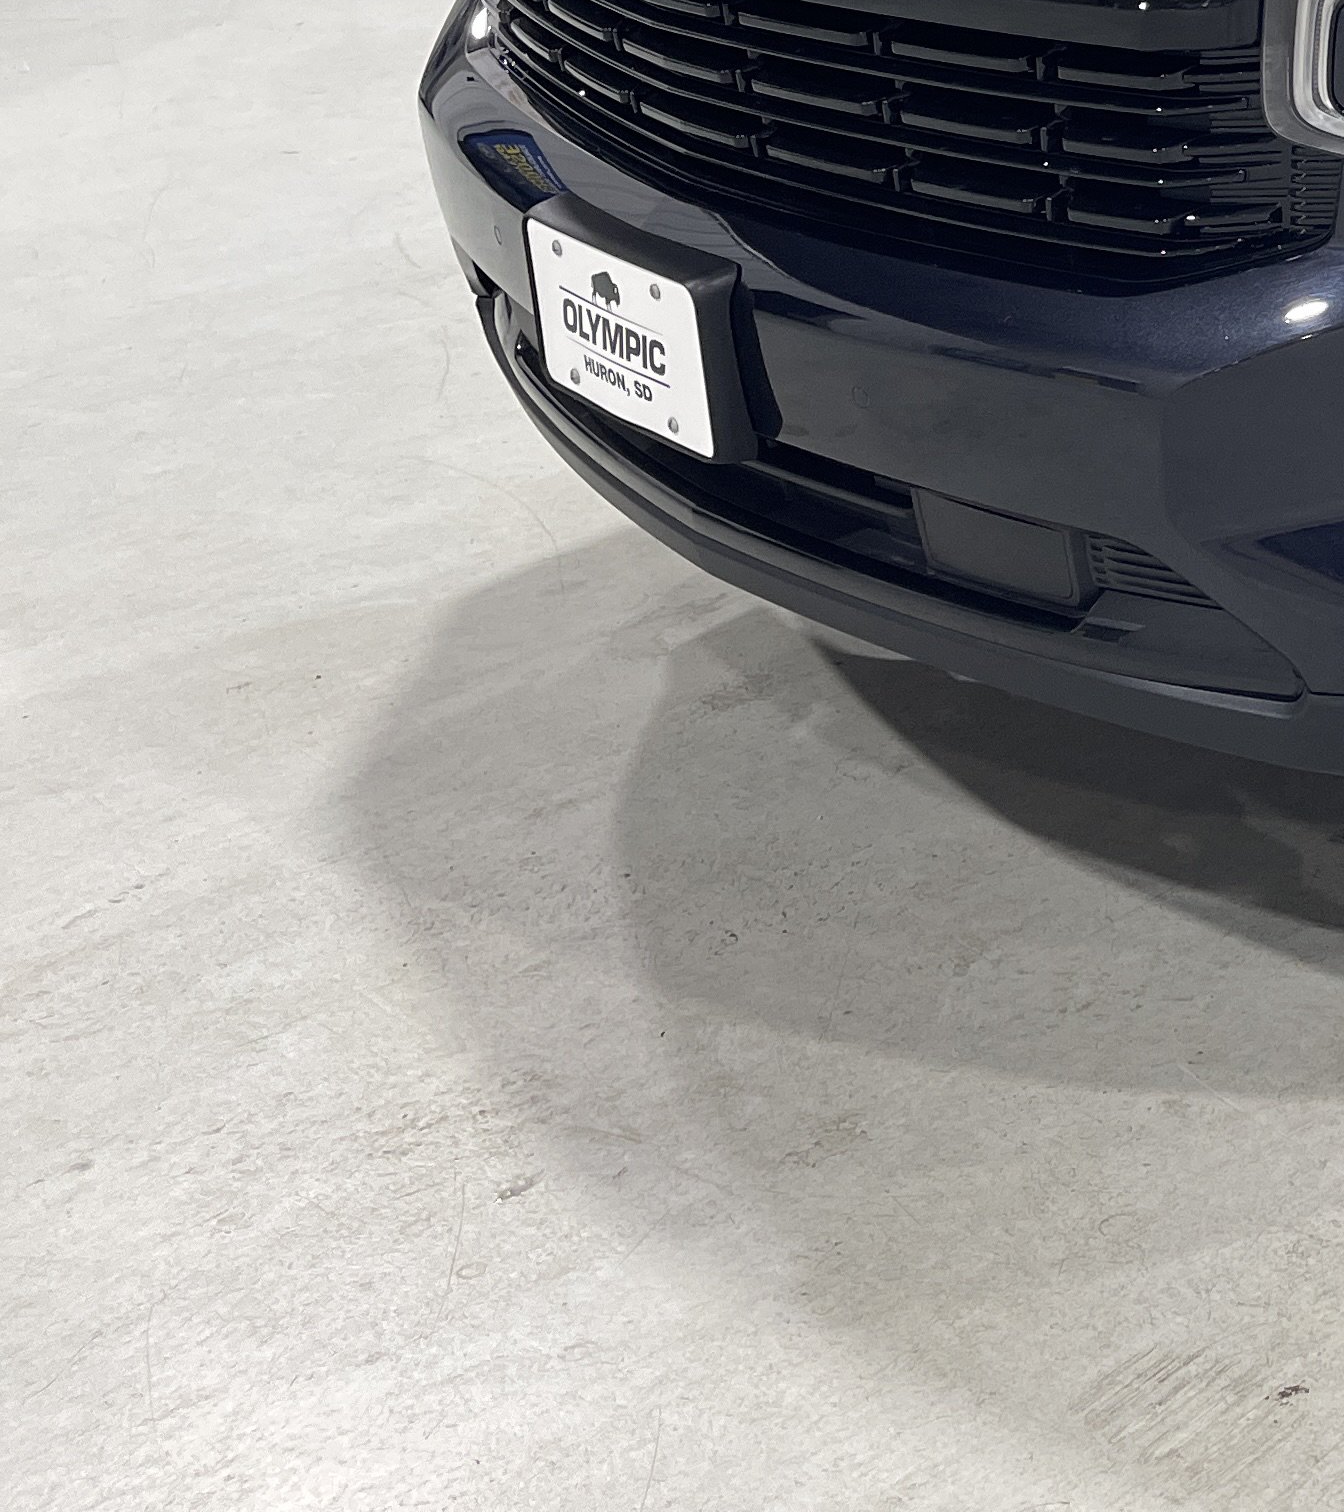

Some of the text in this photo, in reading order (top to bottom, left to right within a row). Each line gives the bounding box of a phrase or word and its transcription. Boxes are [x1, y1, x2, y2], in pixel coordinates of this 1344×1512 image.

[563, 298, 666, 376] OLYMPIC
[584, 354, 653, 402] HURON, SD
